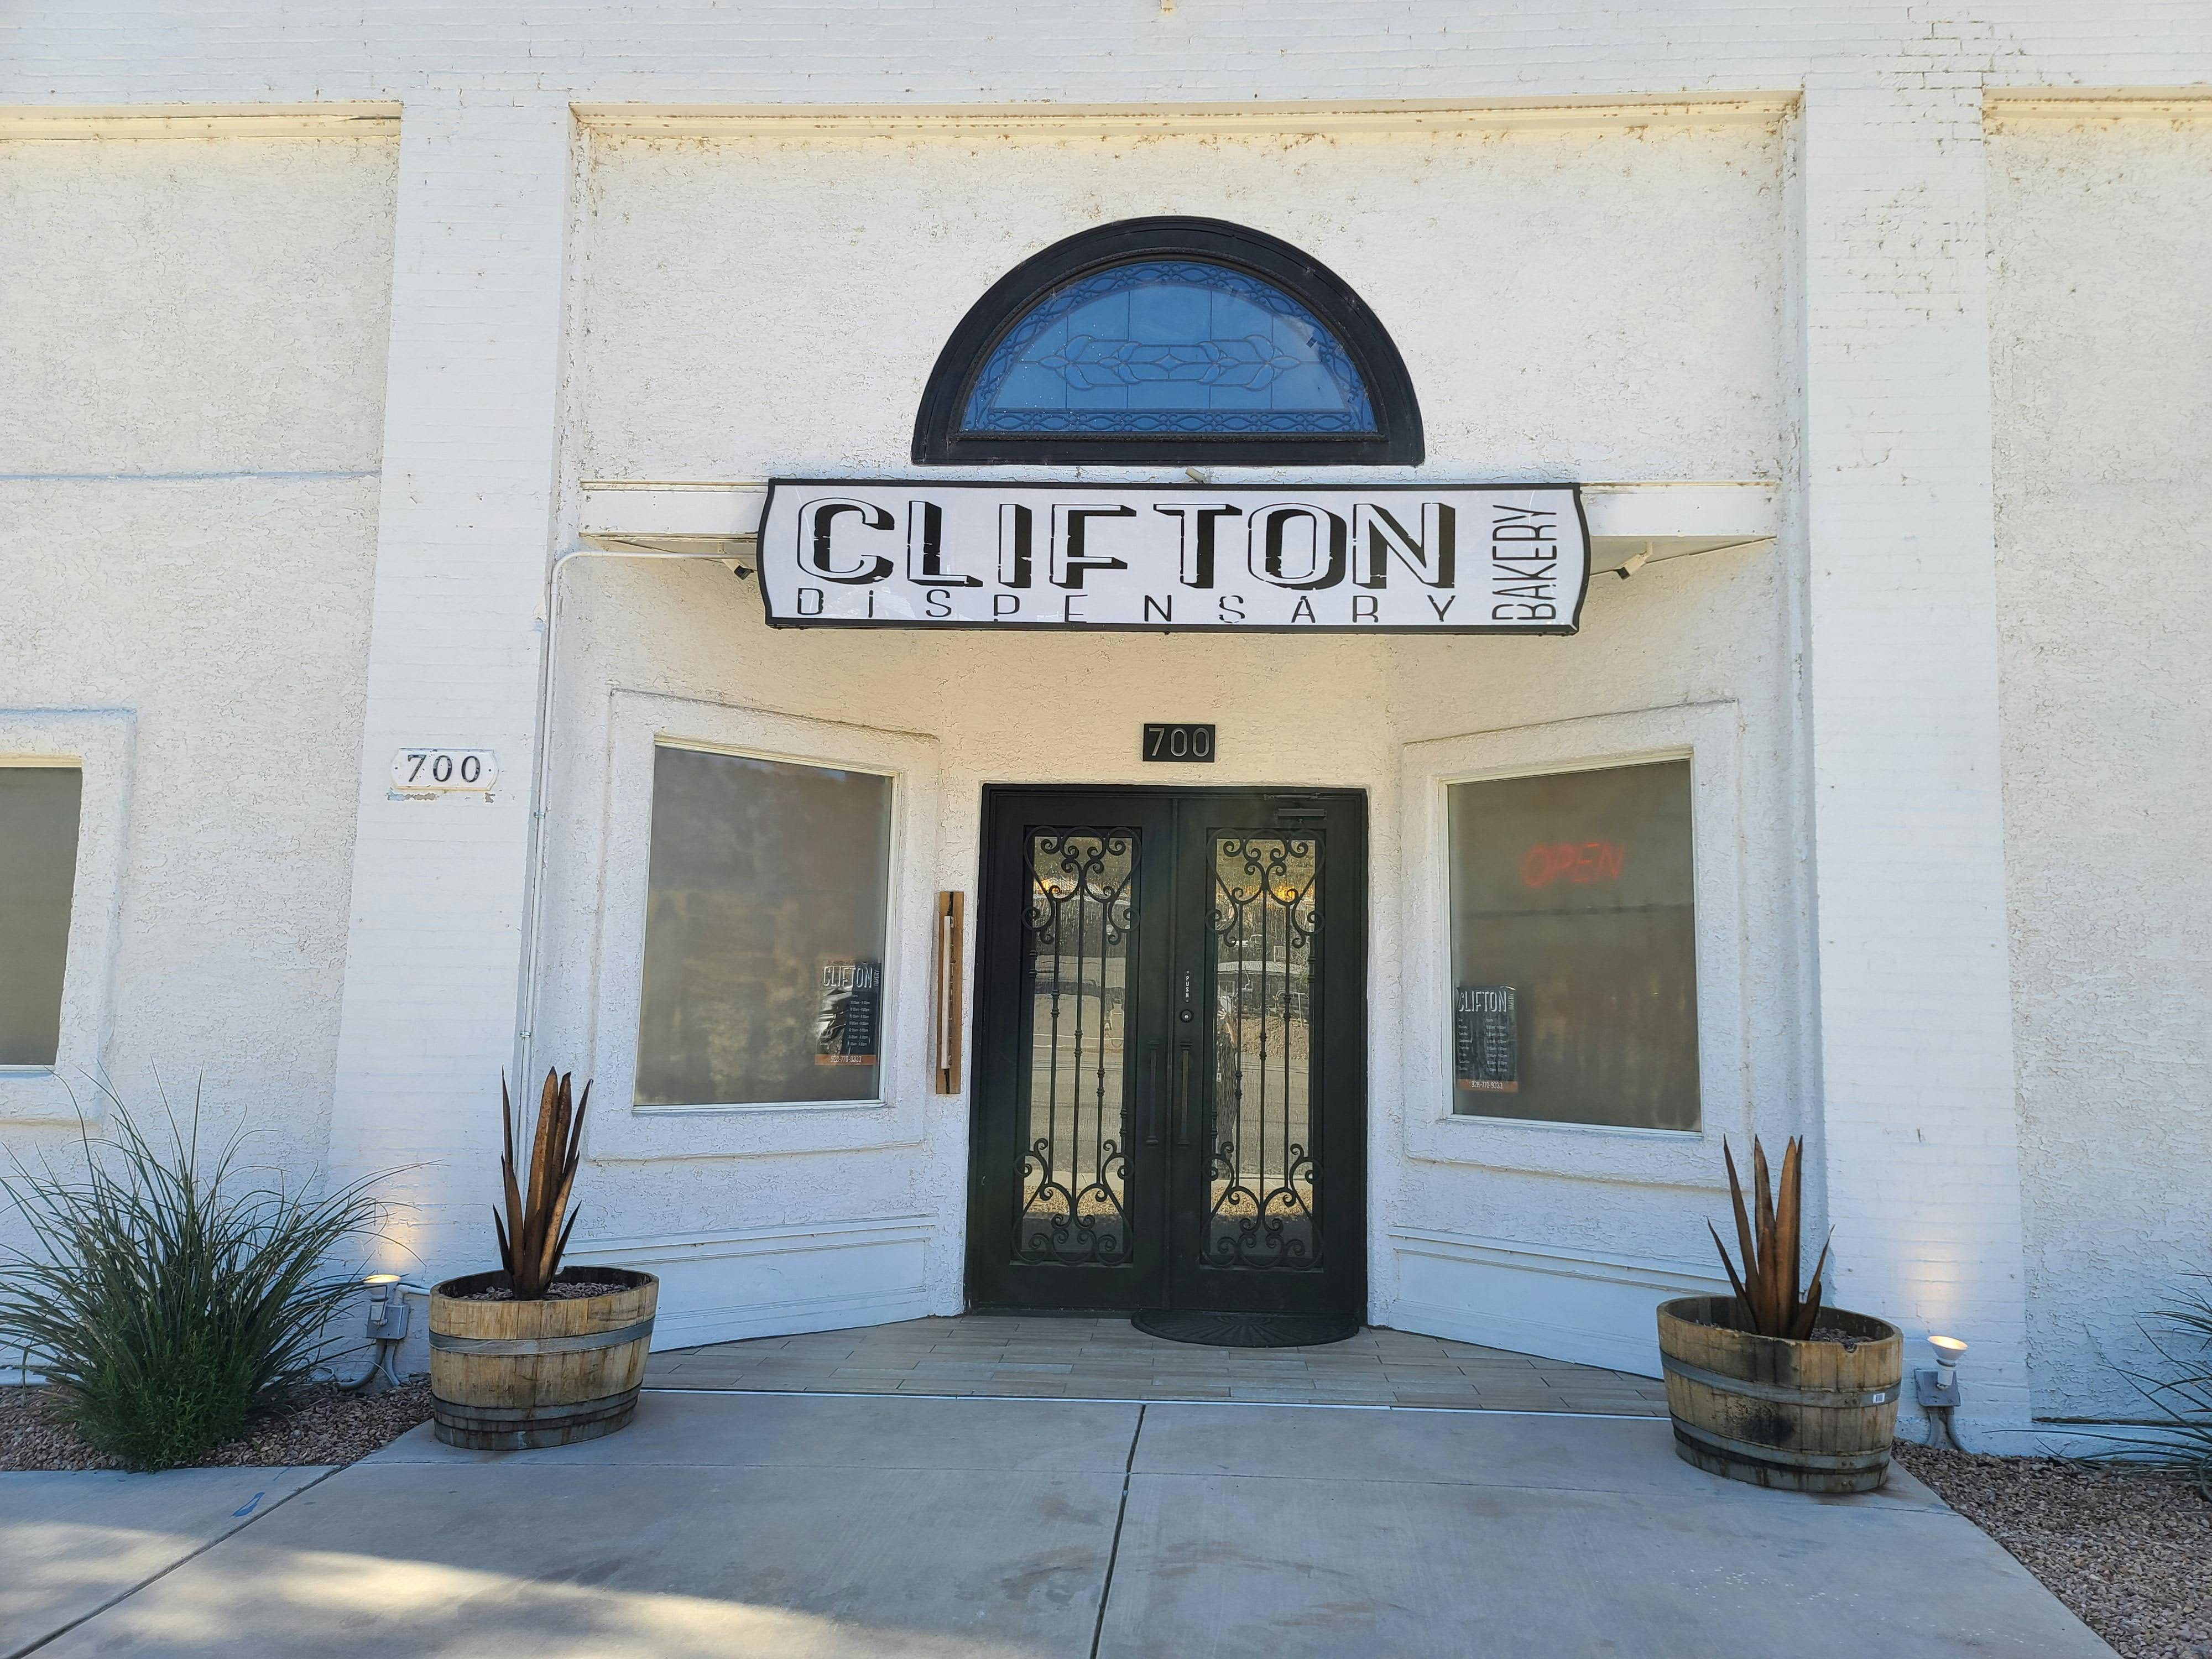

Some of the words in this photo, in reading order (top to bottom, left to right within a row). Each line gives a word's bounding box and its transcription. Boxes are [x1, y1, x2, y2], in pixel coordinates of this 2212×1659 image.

[797, 497, 1455, 590] CLIFTON
[1492, 504, 1557, 620] BAKERY
[797, 588, 1455, 623] DISPENSARY
[1149, 727, 1209, 757] 700
[408, 754, 480, 782] 700
[1521, 841, 1625, 888] OPEN
[822, 965, 872, 988] CLIFTON
[1458, 990, 1507, 1013] CLIFTON
